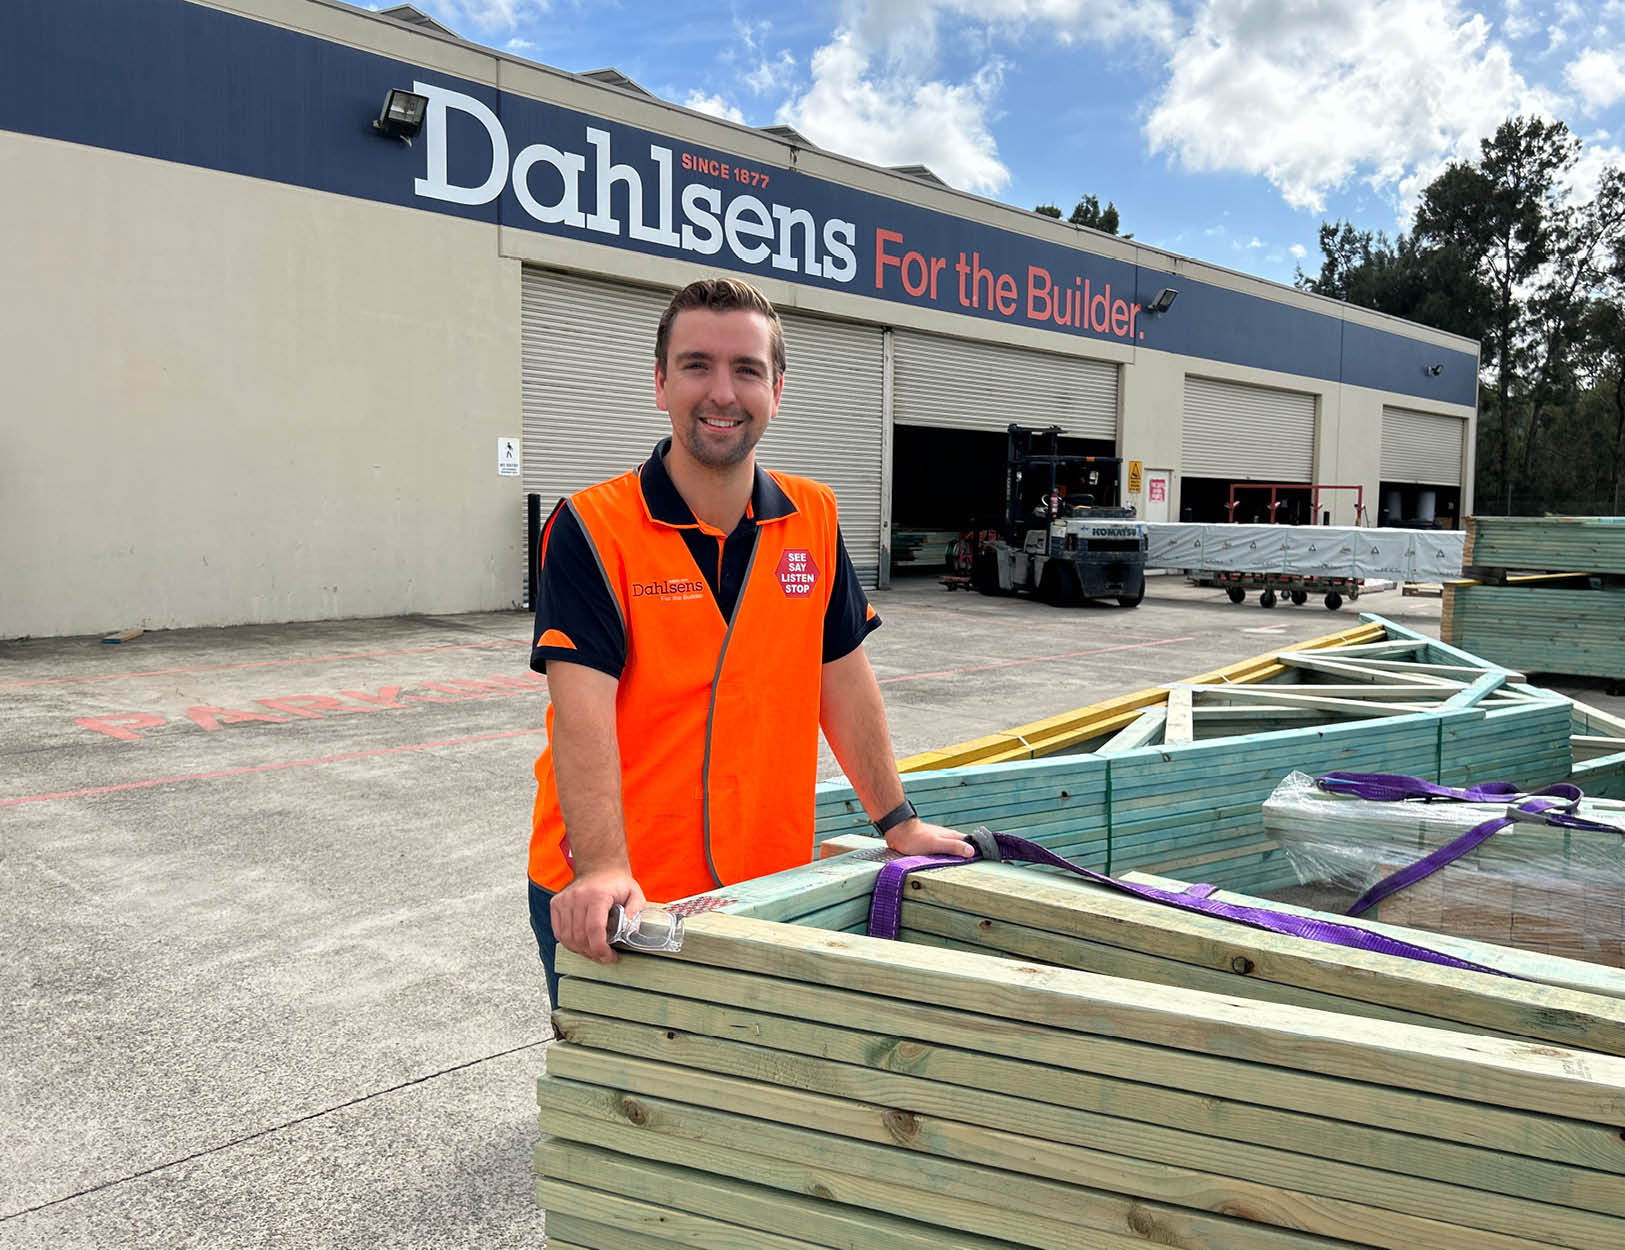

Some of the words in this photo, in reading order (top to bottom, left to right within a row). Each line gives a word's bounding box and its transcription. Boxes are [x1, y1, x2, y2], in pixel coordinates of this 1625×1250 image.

[682, 153, 729, 179] SINCE
[734, 167, 769, 189] 1877
[412, 80, 857, 283] Dahlsens
[875, 227, 946, 299] For
[955, 252, 1018, 316] the
[1027, 266, 1145, 339] Builder.
[1092, 527, 1137, 536] KOMATSU
[788, 553, 807, 562] SEE
[788, 563, 807, 572] SAY
[781, 573, 814, 583] LISTEN
[632, 581, 704, 597] Dahlsens
[785, 584, 810, 593] STOP
